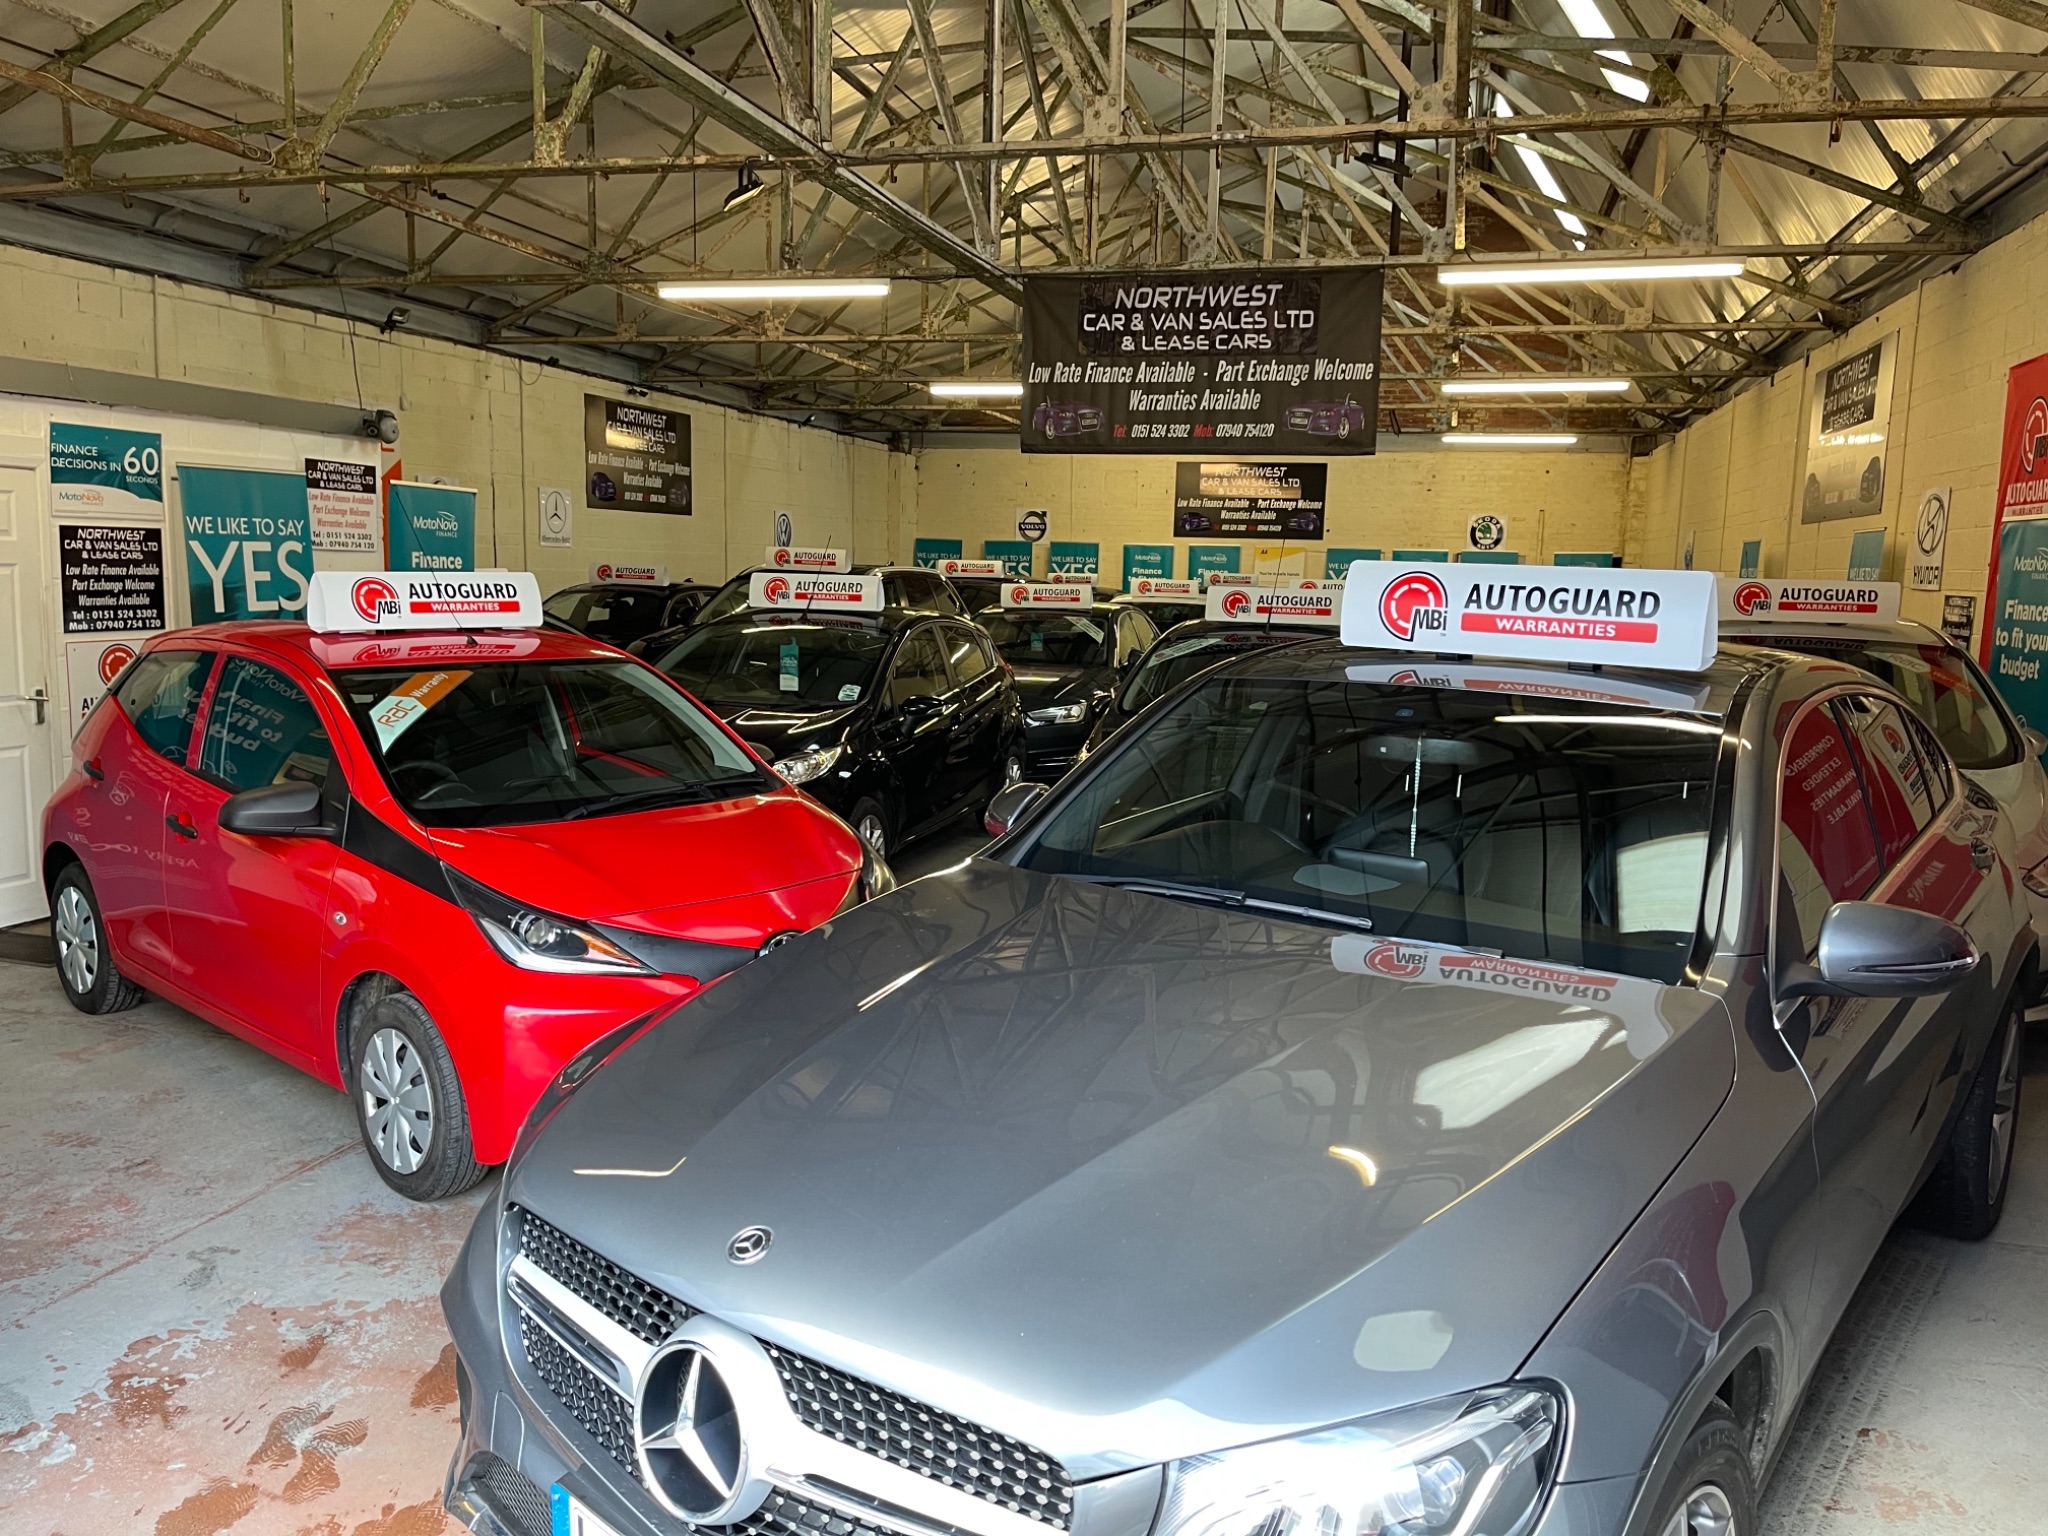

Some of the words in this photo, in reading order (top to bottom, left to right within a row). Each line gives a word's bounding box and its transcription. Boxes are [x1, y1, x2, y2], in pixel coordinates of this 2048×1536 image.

[1115, 284, 1283, 309] NORTHWEST
[1084, 313, 1125, 331] CAR
[1131, 313, 1144, 330] &
[1151, 313, 1193, 330] VAN
[1199, 311, 1267, 329] SALES
[1274, 310, 1314, 328] LTD
[1121, 336, 1135, 350] &
[1142, 335, 1209, 350] LEASE
[1216, 334, 1271, 349] CARS
[1029, 362, 1051, 383] Low
[1053, 362, 1082, 383] Rate
[1085, 362, 1134, 383] Finance
[1136, 361, 1195, 383] Available
[1216, 361, 1245, 381] Part
[1247, 360, 1309, 386] Exchange
[1314, 358, 1374, 380] Welcome
[1129, 390, 1197, 411] Warranties
[1200, 389, 1261, 410] Available
[617, 407, 667, 428] NORTHWEST
[643, 428, 664, 441] SALES
[664, 433, 676, 443] LTD
[1131, 424, 1149, 437] 0151
[1151, 424, 1166, 437] 524
[1168, 424, 1190, 437] 3302
[1216, 424, 1242, 437] 07940
[1244, 424, 1274, 437] 754120
[51, 443, 98, 456] FINANCE
[649, 443, 665, 453] CARS
[51, 458, 107, 470] DECISIONS
[110, 463, 121, 471] IN
[124, 447, 159, 475] 60
[318, 462, 365, 474] NORTHWEST
[308, 470, 321, 479] CAR
[1216, 467, 1287, 477] NORTHWEST
[126, 476, 158, 484] SECONDS
[1202, 478, 1220, 486] CAR
[1252, 479, 1280, 487] SALES
[1283, 479, 1300, 487] LTD
[2006, 479, 2048, 505] AUTOGUAR
[186, 516, 214, 534] WE
[218, 517, 250, 535] LIKE
[252, 518, 274, 535] TO
[278, 519, 304, 536] SAY
[413, 516, 458, 530] MotoNovo
[78, 529, 145, 540] NORTHWEST
[65, 540, 82, 549] CAR
[85, 541, 92, 549] &
[93, 541, 112, 550] VAN
[114, 542, 140, 550] SALES
[143, 542, 158, 551] LTD
[91, 551, 119, 559] LEASE
[121, 552, 143, 560] CARS
[412, 552, 462, 569] Finance
[794, 552, 836, 560] AUTOGUARD
[66, 564, 80, 575] Low
[82, 564, 99, 575] Rate
[101, 564, 127, 575] Finance
[129, 564, 159, 575] Available
[2014, 556, 2048, 571] MotoNov
[189, 540, 309, 613] YES
[1913, 565, 1940, 585] HYUNDAI
[72, 579, 88, 590] Part
[89, 578, 123, 593] Exchange
[125, 578, 155, 590] Welcome
[409, 583, 517, 599] AUTOGUARD
[795, 581, 862, 592] AUTOGUARD
[1033, 588, 1080, 596] AUTOGUARD
[79, 595, 117, 606] Warranties
[119, 593, 150, 605] Available
[1258, 595, 1332, 607] AUTOGUARD
[1464, 584, 1660, 619] AUTOGUARD
[1780, 588, 1878, 602] AUTOGUARD
[378, 600, 401, 615] MBi
[431, 602, 499, 611] WARRANTIES
[1753, 600, 1771, 611] MBi
[2005, 599, 2048, 622] Finance
[72, 611, 84, 619] Tel
[92, 611, 113, 619] 0151
[118, 610, 133, 618] 524
[136, 609, 157, 617] 3302
[1413, 607, 1447, 632] MBi
[69, 622, 88, 630] Mob
[96, 621, 124, 629] 07940
[127, 620, 142, 628] 754
[1496, 618, 1616, 637] WARRANTIES
[1996, 627, 2008, 646] to
[2011, 627, 2023, 648] fit
[2000, 654, 2040, 681] budget
[409, 672, 448, 697] Warranty
